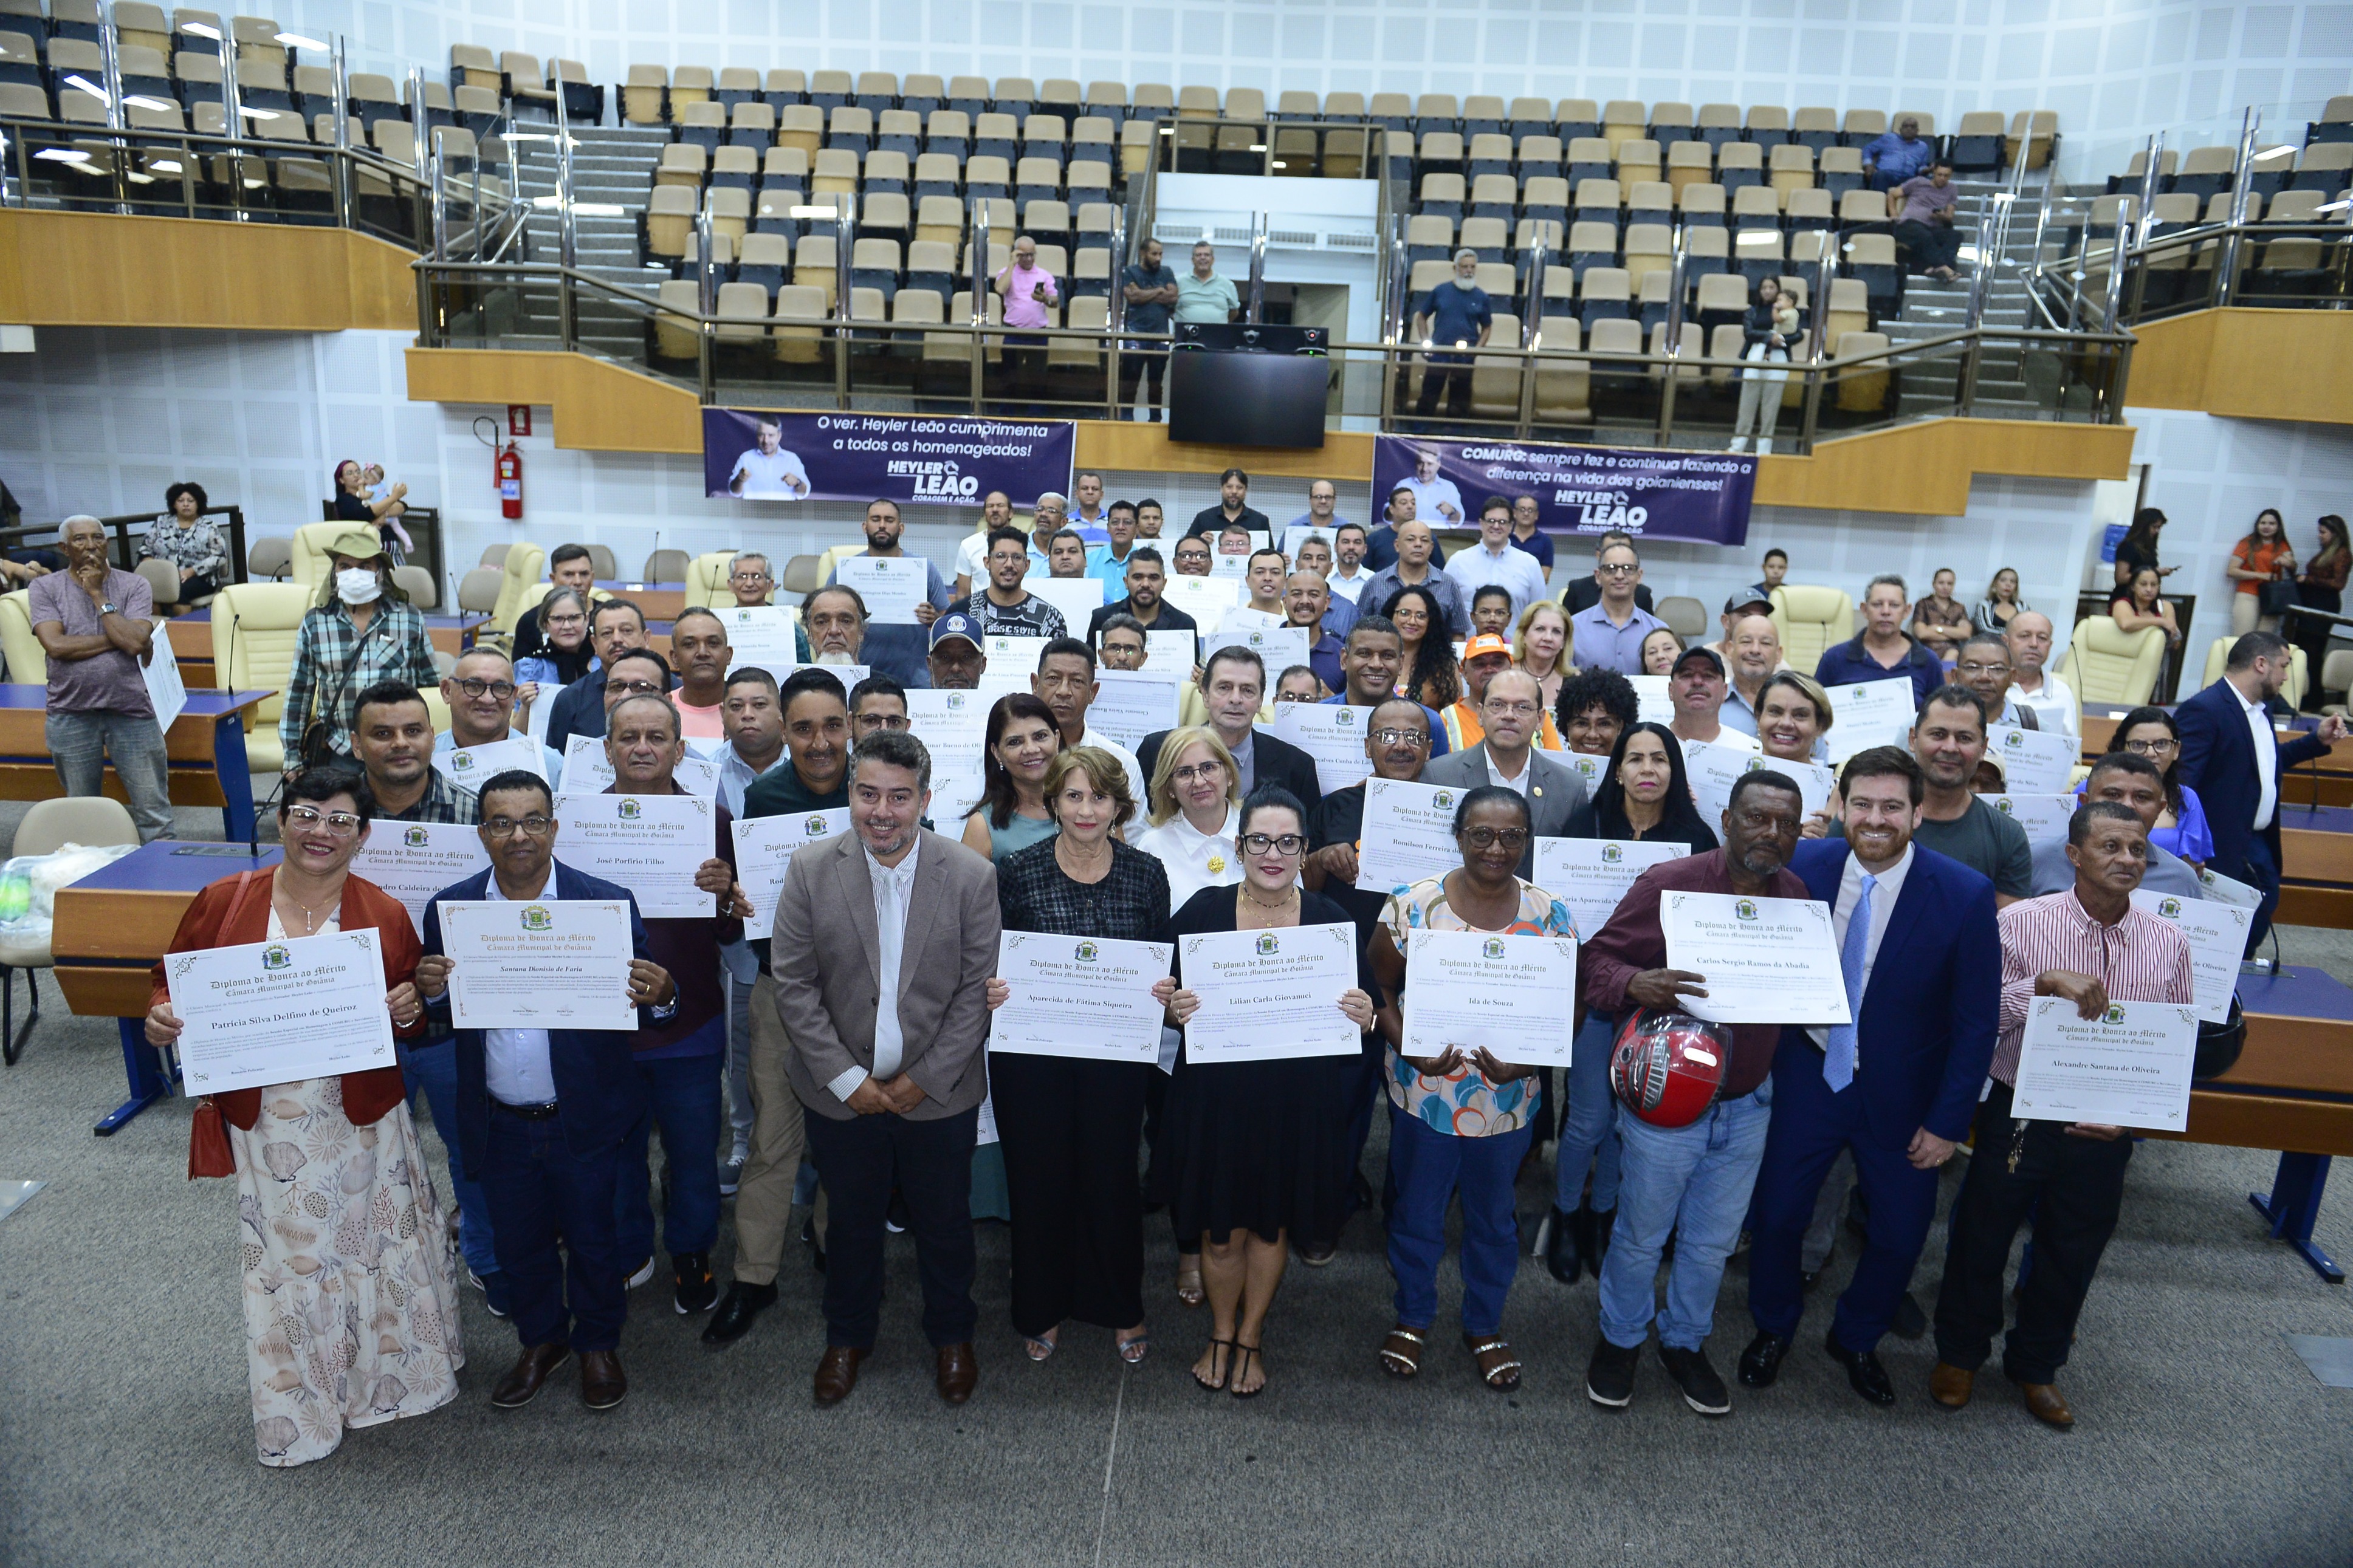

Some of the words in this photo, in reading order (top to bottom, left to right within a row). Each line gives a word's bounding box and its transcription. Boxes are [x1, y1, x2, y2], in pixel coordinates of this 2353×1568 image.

[817, 416, 830, 429] O
[833, 419, 858, 430] ver.
[862, 418, 909, 434] Heyler
[911, 420, 946, 433] Leão
[949, 421, 1048, 439] cumprimenta
[833, 439, 843, 450] a
[848, 437, 888, 451] todos
[892, 441, 909, 452] os
[913, 439, 1032, 459] homenageados!
[887, 460, 943, 474] HEYLER
[1462, 447, 1527, 462] COMURG:
[1529, 453, 1581, 467] sempre
[1584, 453, 1604, 467] fez
[1606, 457, 1616, 467] e
[1618, 457, 1680, 471] continua
[1681, 458, 1739, 473] fazendo
[1740, 463, 1751, 474] a
[1486, 467, 1551, 485] diferença
[1553, 472, 1572, 484] na
[1575, 471, 1604, 485] vida
[1607, 473, 1633, 487] dos
[1635, 475, 1723, 491] goianienses!
[1554, 489, 1613, 505] HEYLER
[574, 821, 606, 830] Diploma
[658, 822, 685, 830] Mérito
[1393, 838, 1423, 849] Romilson
[1425, 843, 1450, 853] Ferreira
[358, 847, 392, 857] Diploma
[407, 849, 432, 857] Honra
[446, 851, 474, 860] Mérito
[568, 933, 596, 942] Mérito
[1029, 959, 1062, 970] Diploma
[1075, 964, 1099, 972] Honra
[1112, 967, 1138, 975] Mérito
[1212, 962, 1245, 970] Diploma
[1259, 959, 1283, 967] Honra
[1297, 954, 1324, 964] Mérito
[1439, 959, 1471, 968] Diploma
[1485, 961, 1508, 970] Honra
[1520, 964, 1546, 973] Mérito
[2202, 963, 2227, 971] Oliveira
[210, 979, 251, 990] Diploma
[267, 973, 298, 982] Honra
[314, 965, 346, 976] Mérito
[1028, 995, 1063, 1003] Aparecida
[1103, 1001, 1132, 1009] Siqueira
[211, 1019, 246, 1029] Patrícia
[273, 1012, 307, 1021] Delfino
[322, 1005, 357, 1016] Queiroz
[2058, 1025, 2089, 1035] Diploma
[2102, 1027, 2126, 1036] Honra
[2139, 1030, 2166, 1038] Mérito
